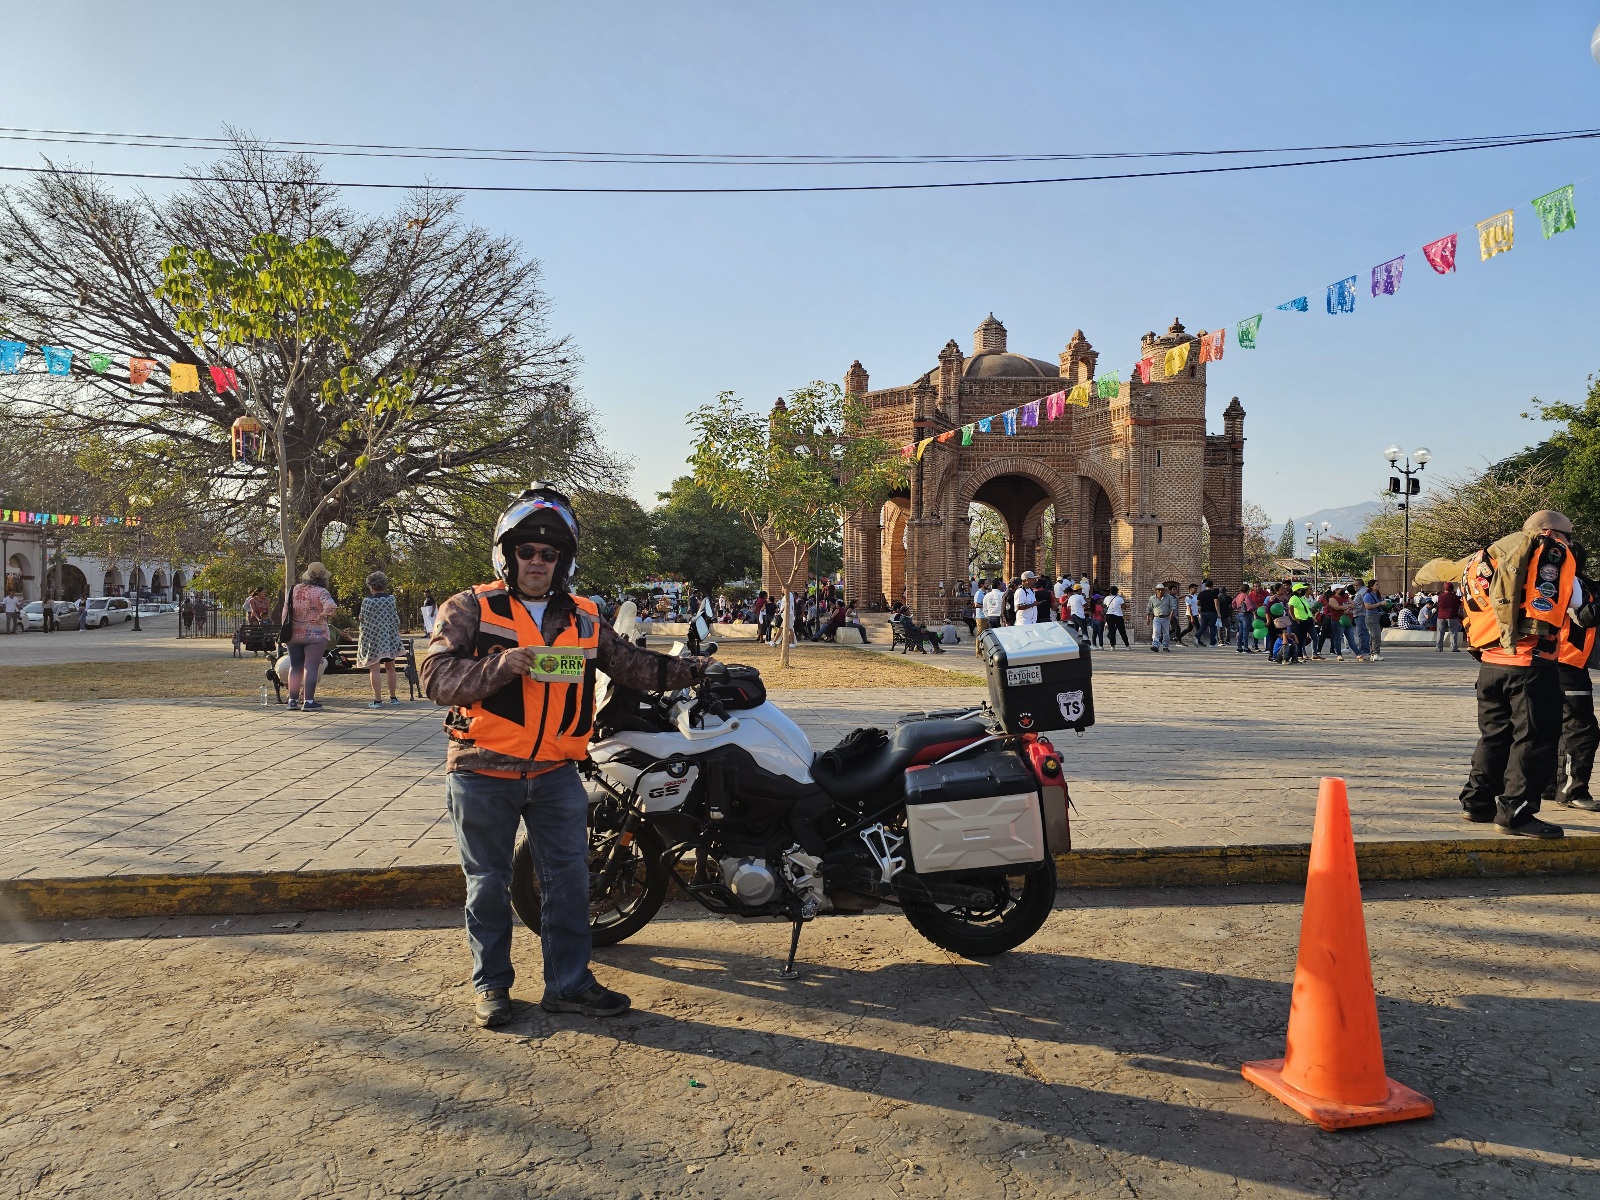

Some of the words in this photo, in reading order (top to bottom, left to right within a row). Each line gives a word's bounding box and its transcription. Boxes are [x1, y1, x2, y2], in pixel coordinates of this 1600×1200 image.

[561, 660, 584, 670] RRM
[1009, 671, 1040, 681] CATORCE
[1063, 701, 1080, 715] TS
[649, 785, 680, 798] GS
